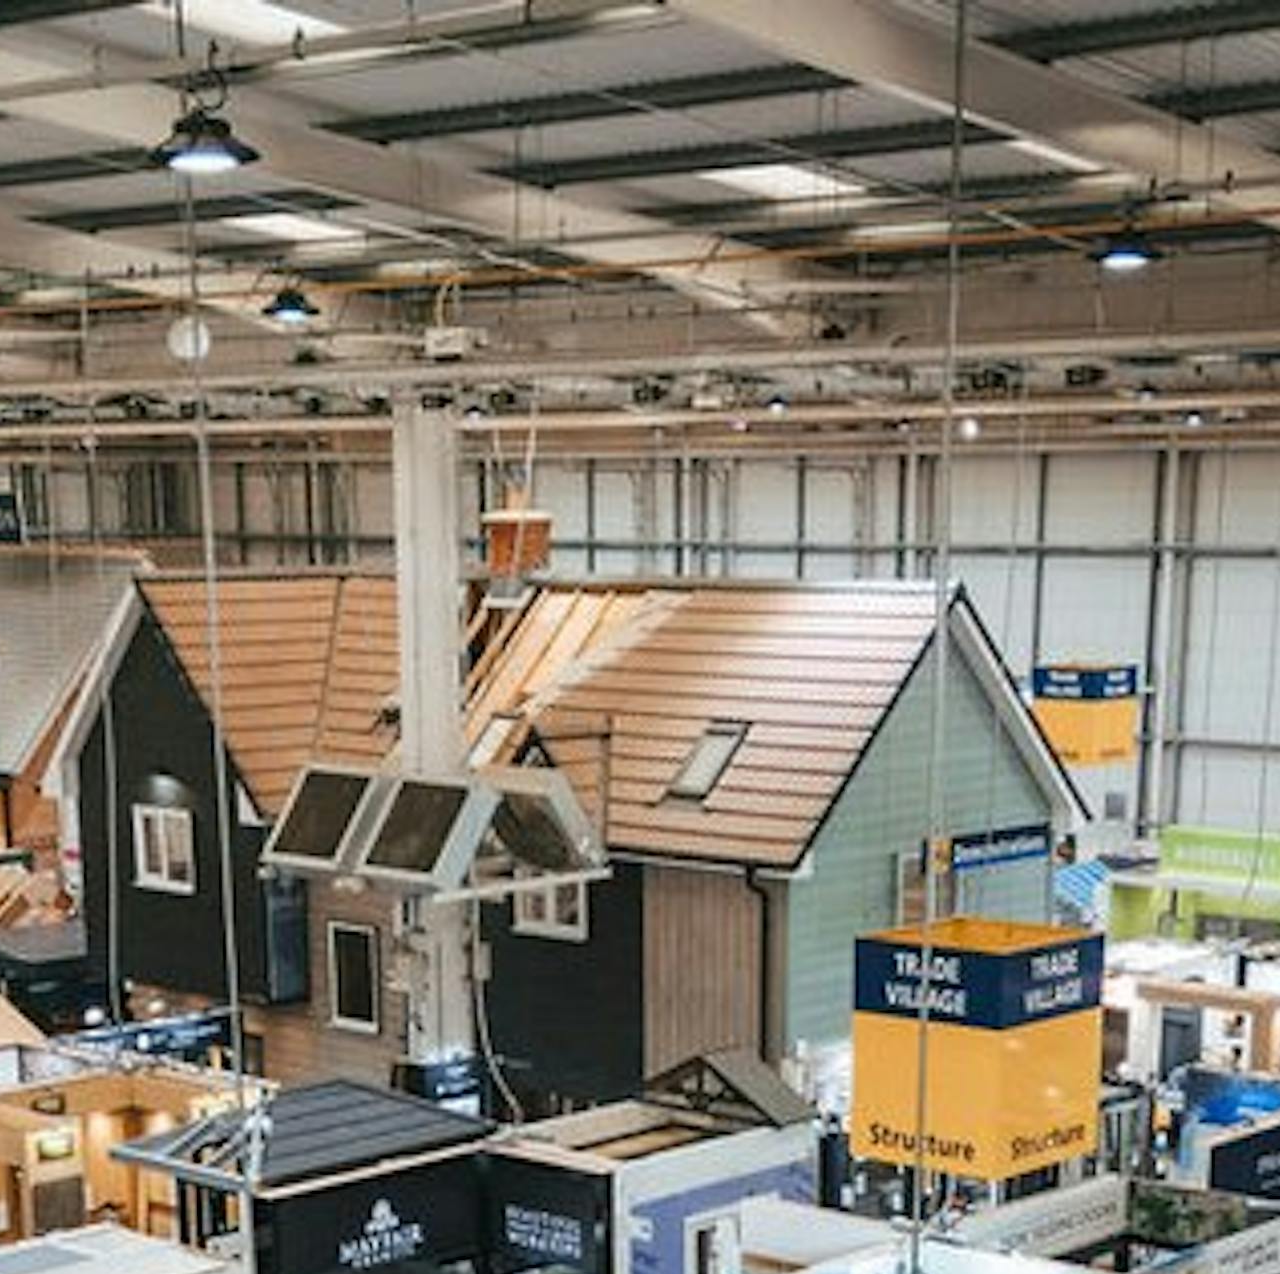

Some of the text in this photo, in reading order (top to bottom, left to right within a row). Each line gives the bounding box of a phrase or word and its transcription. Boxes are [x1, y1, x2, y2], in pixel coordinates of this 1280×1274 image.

[1030, 949, 1079, 981] TRADE
[1023, 979, 1083, 1013] VILLAGE
[1011, 1124, 1086, 1160] Structure
